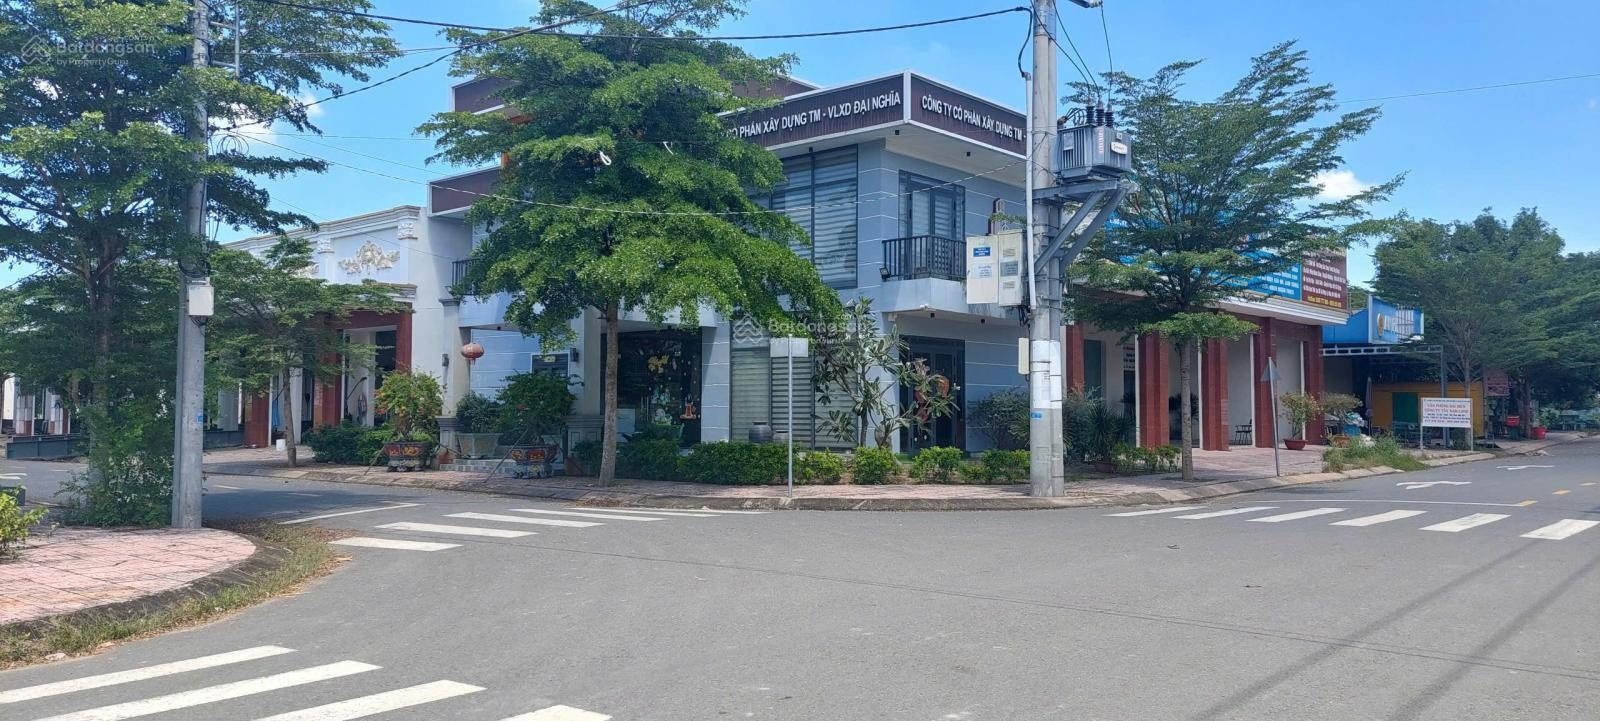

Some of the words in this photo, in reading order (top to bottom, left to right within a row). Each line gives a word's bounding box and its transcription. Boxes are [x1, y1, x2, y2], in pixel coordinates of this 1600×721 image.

[762, 117, 780, 134] XÂY
[781, 112, 807, 131] DỰNG
[808, 108, 821, 123] TM
[827, 102, 852, 119] VLXD
[853, 97, 870, 115] ĐẠI
[872, 90, 901, 110] NGHĨA
[922, 94, 942, 114] CÔNG
[943, 102, 952, 117] TY
[1013, 127, 1022, 141] TM
